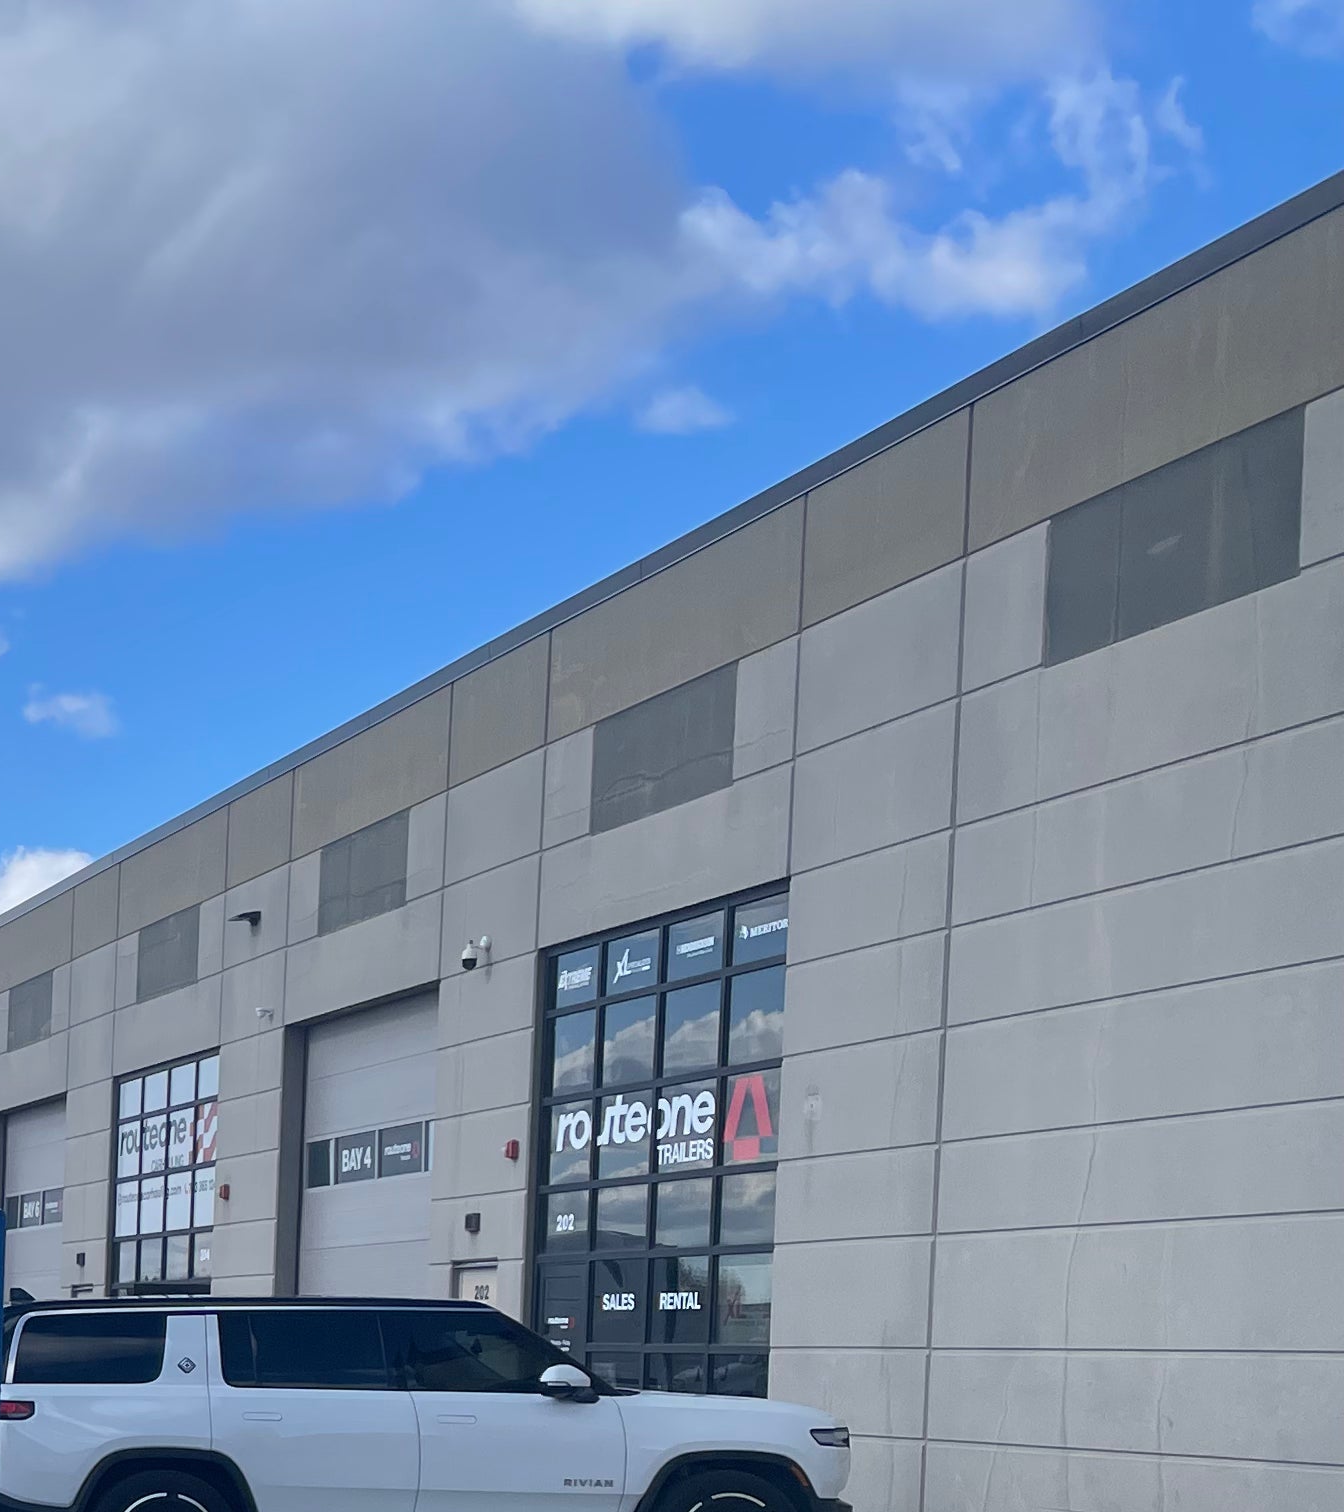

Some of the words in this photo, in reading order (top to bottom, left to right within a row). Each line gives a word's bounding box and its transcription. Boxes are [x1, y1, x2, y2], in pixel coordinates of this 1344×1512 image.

[555, 1090, 716, 1152] routeone
[120, 1116, 187, 1157] routeone
[341, 1146, 364, 1173] BAY
[363, 1145, 372, 1169] 4
[656, 1137, 714, 1166] TRAILERS
[23, 1201, 36, 1219] BAY
[556, 1213, 575, 1232] 202
[474, 1284, 490, 1300] 202
[658, 1291, 701, 1311] RENTAL
[602, 1293, 636, 1311] SALES
[563, 1478, 614, 1488] RIVIAN
